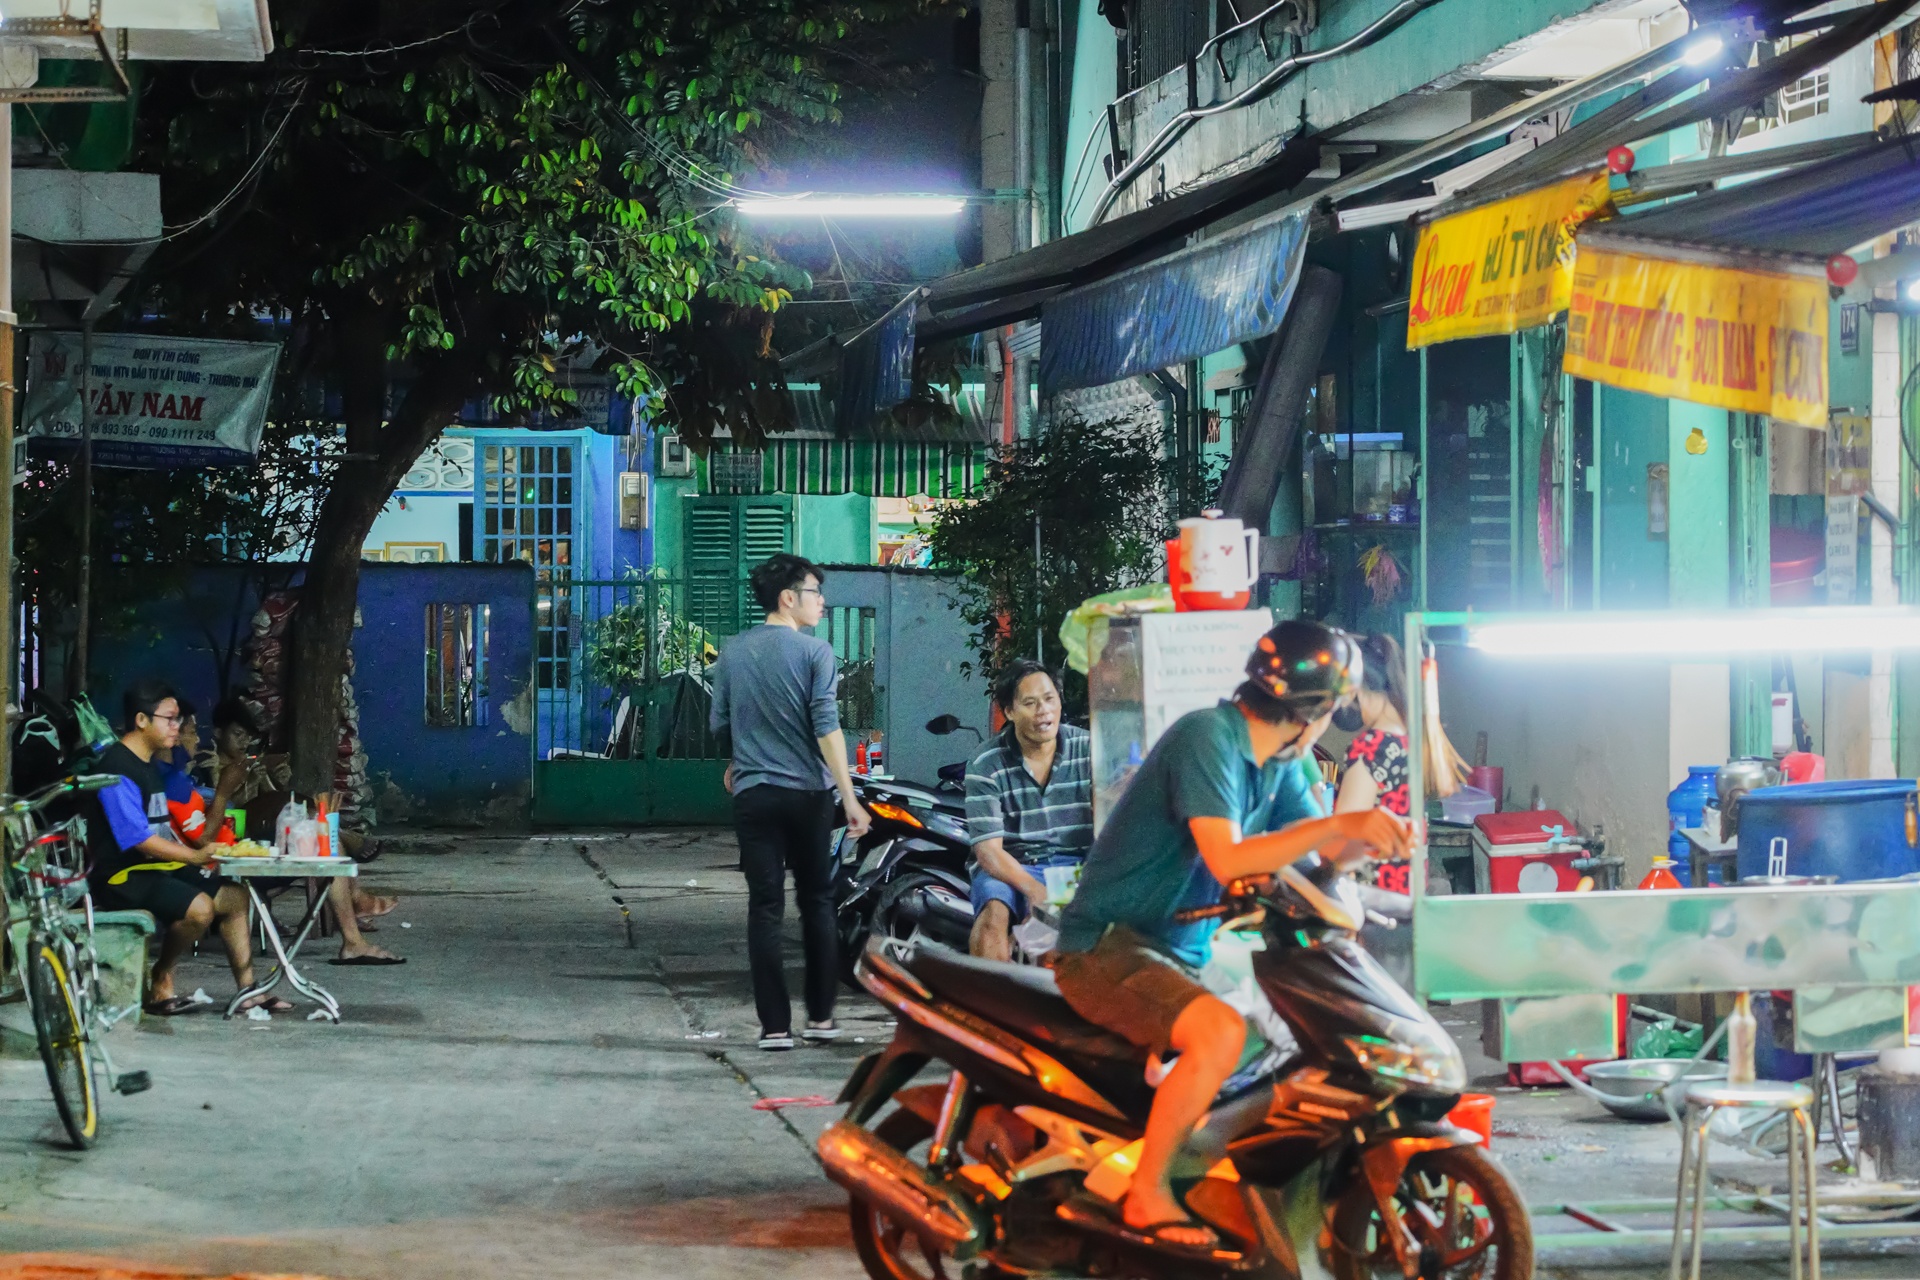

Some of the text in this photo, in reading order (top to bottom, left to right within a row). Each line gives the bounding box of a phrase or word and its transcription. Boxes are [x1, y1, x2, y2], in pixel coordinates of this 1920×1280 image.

[1842, 309, 1856, 334] 174
[77, 383, 206, 421] VĂN NAM
[101, 422, 119, 435] 893
[121, 425, 140, 437] 369
[149, 426, 168, 439] 090
[197, 430, 216, 441] 249
